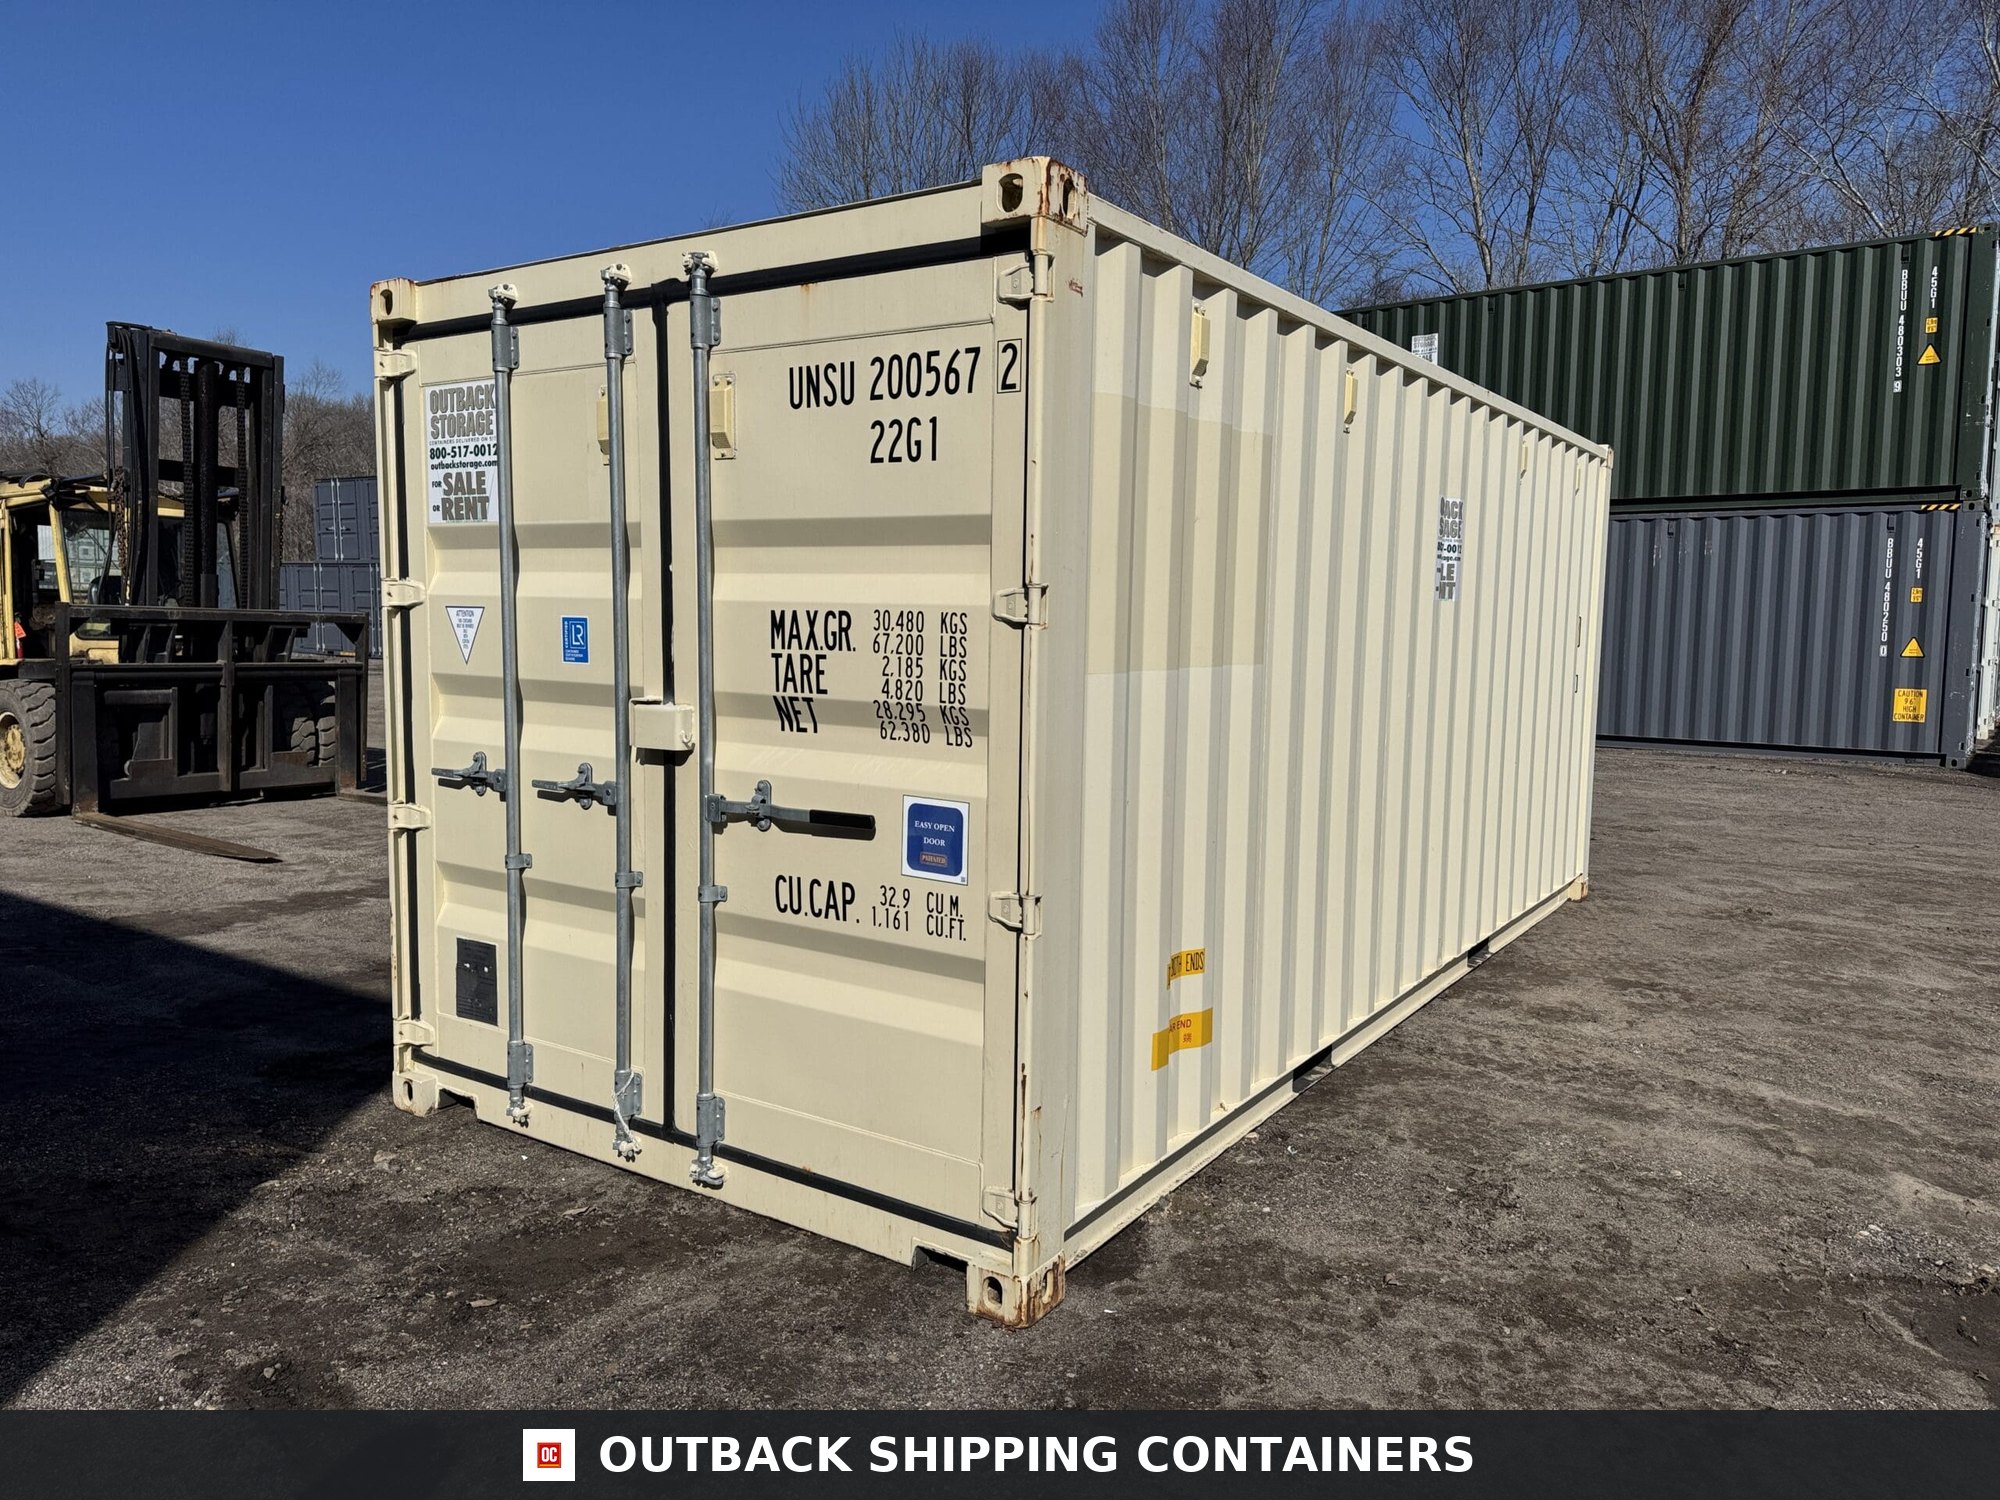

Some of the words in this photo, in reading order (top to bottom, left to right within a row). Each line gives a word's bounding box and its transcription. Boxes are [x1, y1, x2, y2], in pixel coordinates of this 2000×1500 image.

[1900, 269, 1908, 311] BBUU
[1929, 266, 1938, 308] 45G1
[1895, 315, 1904, 377] 480303
[789, 361, 855, 409] UNSU
[869, 346, 981, 401] 200567
[1000, 343, 1018, 390] 2
[429, 383, 496, 415] OUTBACK
[430, 410, 494, 440] STORAGE
[429, 443, 498, 460] 800-517-0012
[870, 416, 938, 464] 22G1
[430, 460, 498, 471] outbackstorage.com
[443, 471, 487, 496] SALE
[441, 496, 490, 521] RENT
[1885, 538, 1893, 579] BBUU
[1915, 538, 1923, 579] 45G1
[1881, 582, 1891, 642] 480250
[572, 624, 584, 645] LR
[770, 610, 856, 651] MAX.GR.
[873, 609, 924, 633] 30,480
[940, 612, 967, 635] KGS
[873, 633, 924, 656] 67,200
[940, 635, 967, 658] LBS
[771, 653, 828, 694] TARE
[882, 655, 923, 679] 2,185
[940, 658, 966, 682] KGS
[881, 678, 923, 702] 4,820
[939, 682, 966, 705] LBS
[773, 695, 818, 733] NET
[940, 705, 970, 726] KGS
[1894, 713, 1924, 721] CONTAINER
[880, 720, 930, 744] 62,380
[945, 725, 973, 748] LBS
[914, 820, 932, 829] EASY
[933, 823, 955, 832] OPEN
[923, 837, 946, 846] DOOR
[775, 874, 860, 924] CU.CAP.
[880, 885, 911, 909] 32.9
[872, 906, 909, 932] 1,161
[1185, 951, 1204, 972] ENDS
[1176, 1019, 1192, 1030] END
